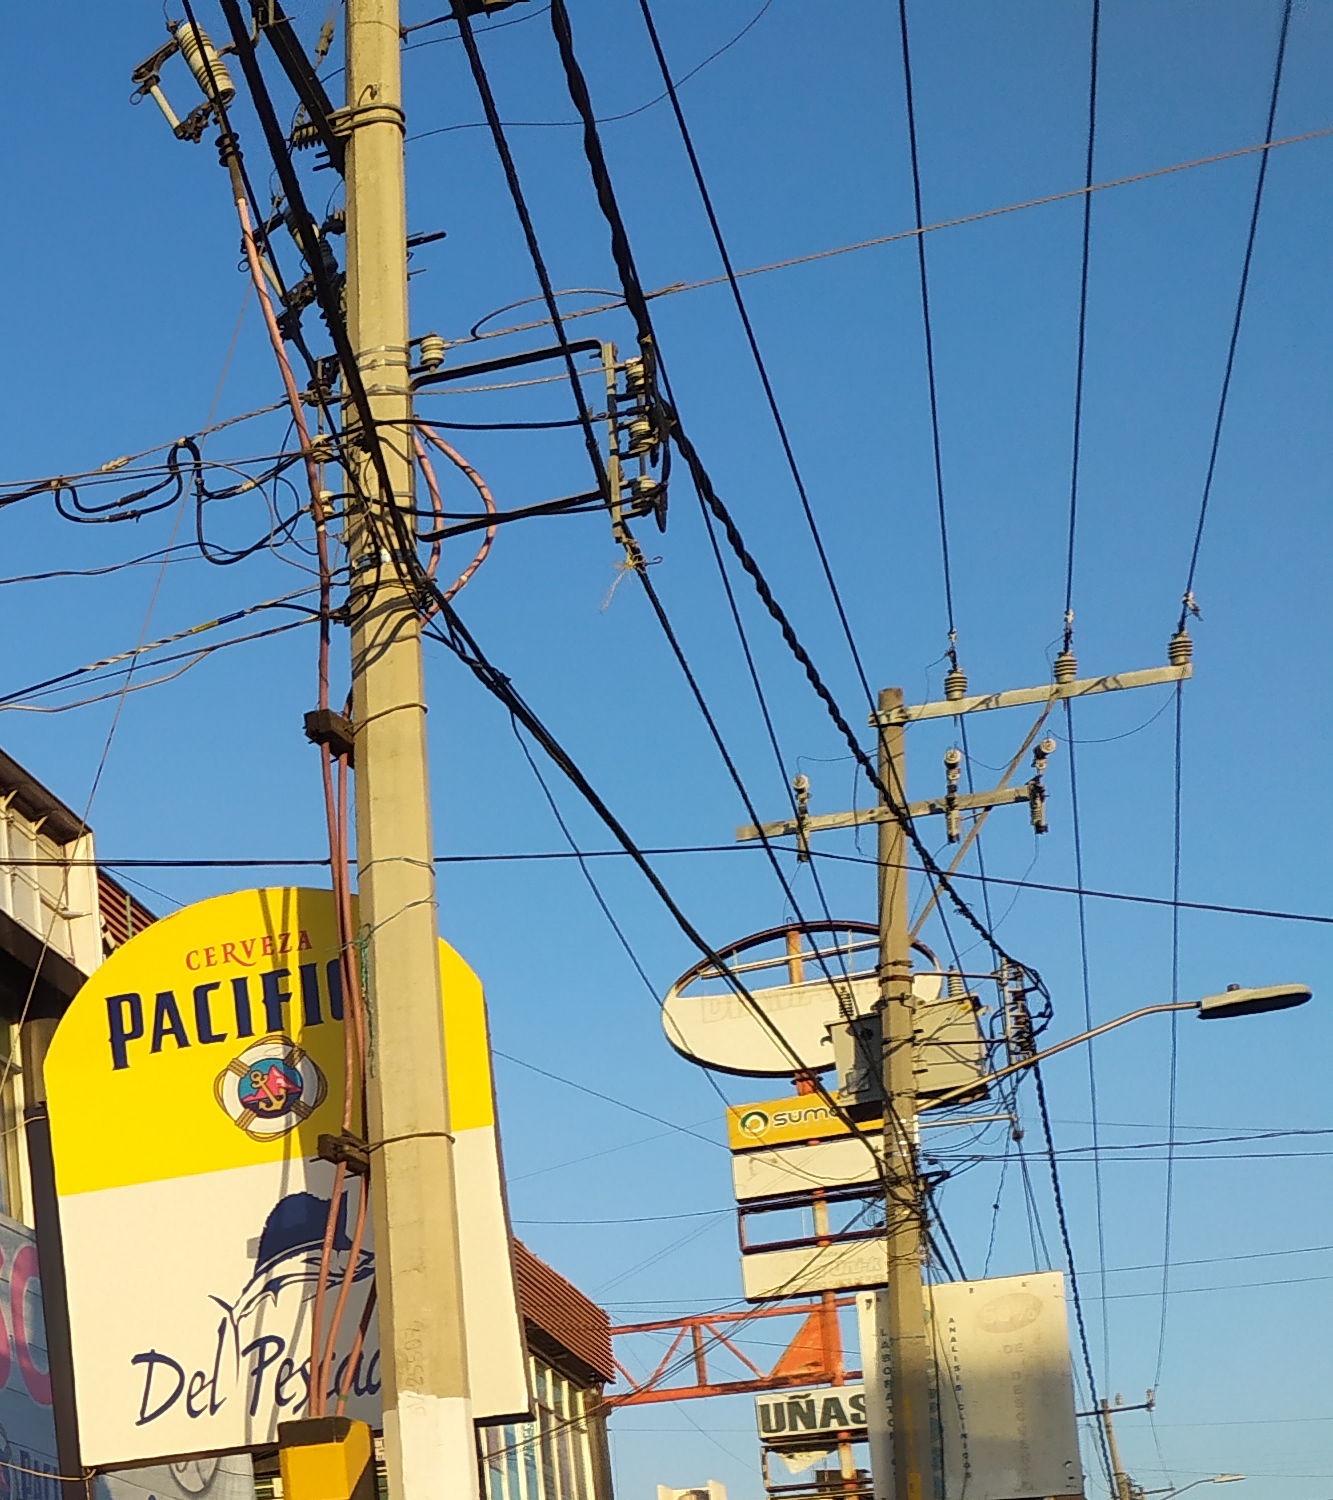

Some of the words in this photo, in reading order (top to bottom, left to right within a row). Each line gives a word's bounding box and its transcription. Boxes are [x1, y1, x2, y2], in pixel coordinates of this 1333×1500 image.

[186, 930, 313, 970] CERVEZA
[104, 958, 345, 1071] PACIFI
[132, 1316, 228, 1427] Del
[759, 1392, 868, 1433] UÑAS
